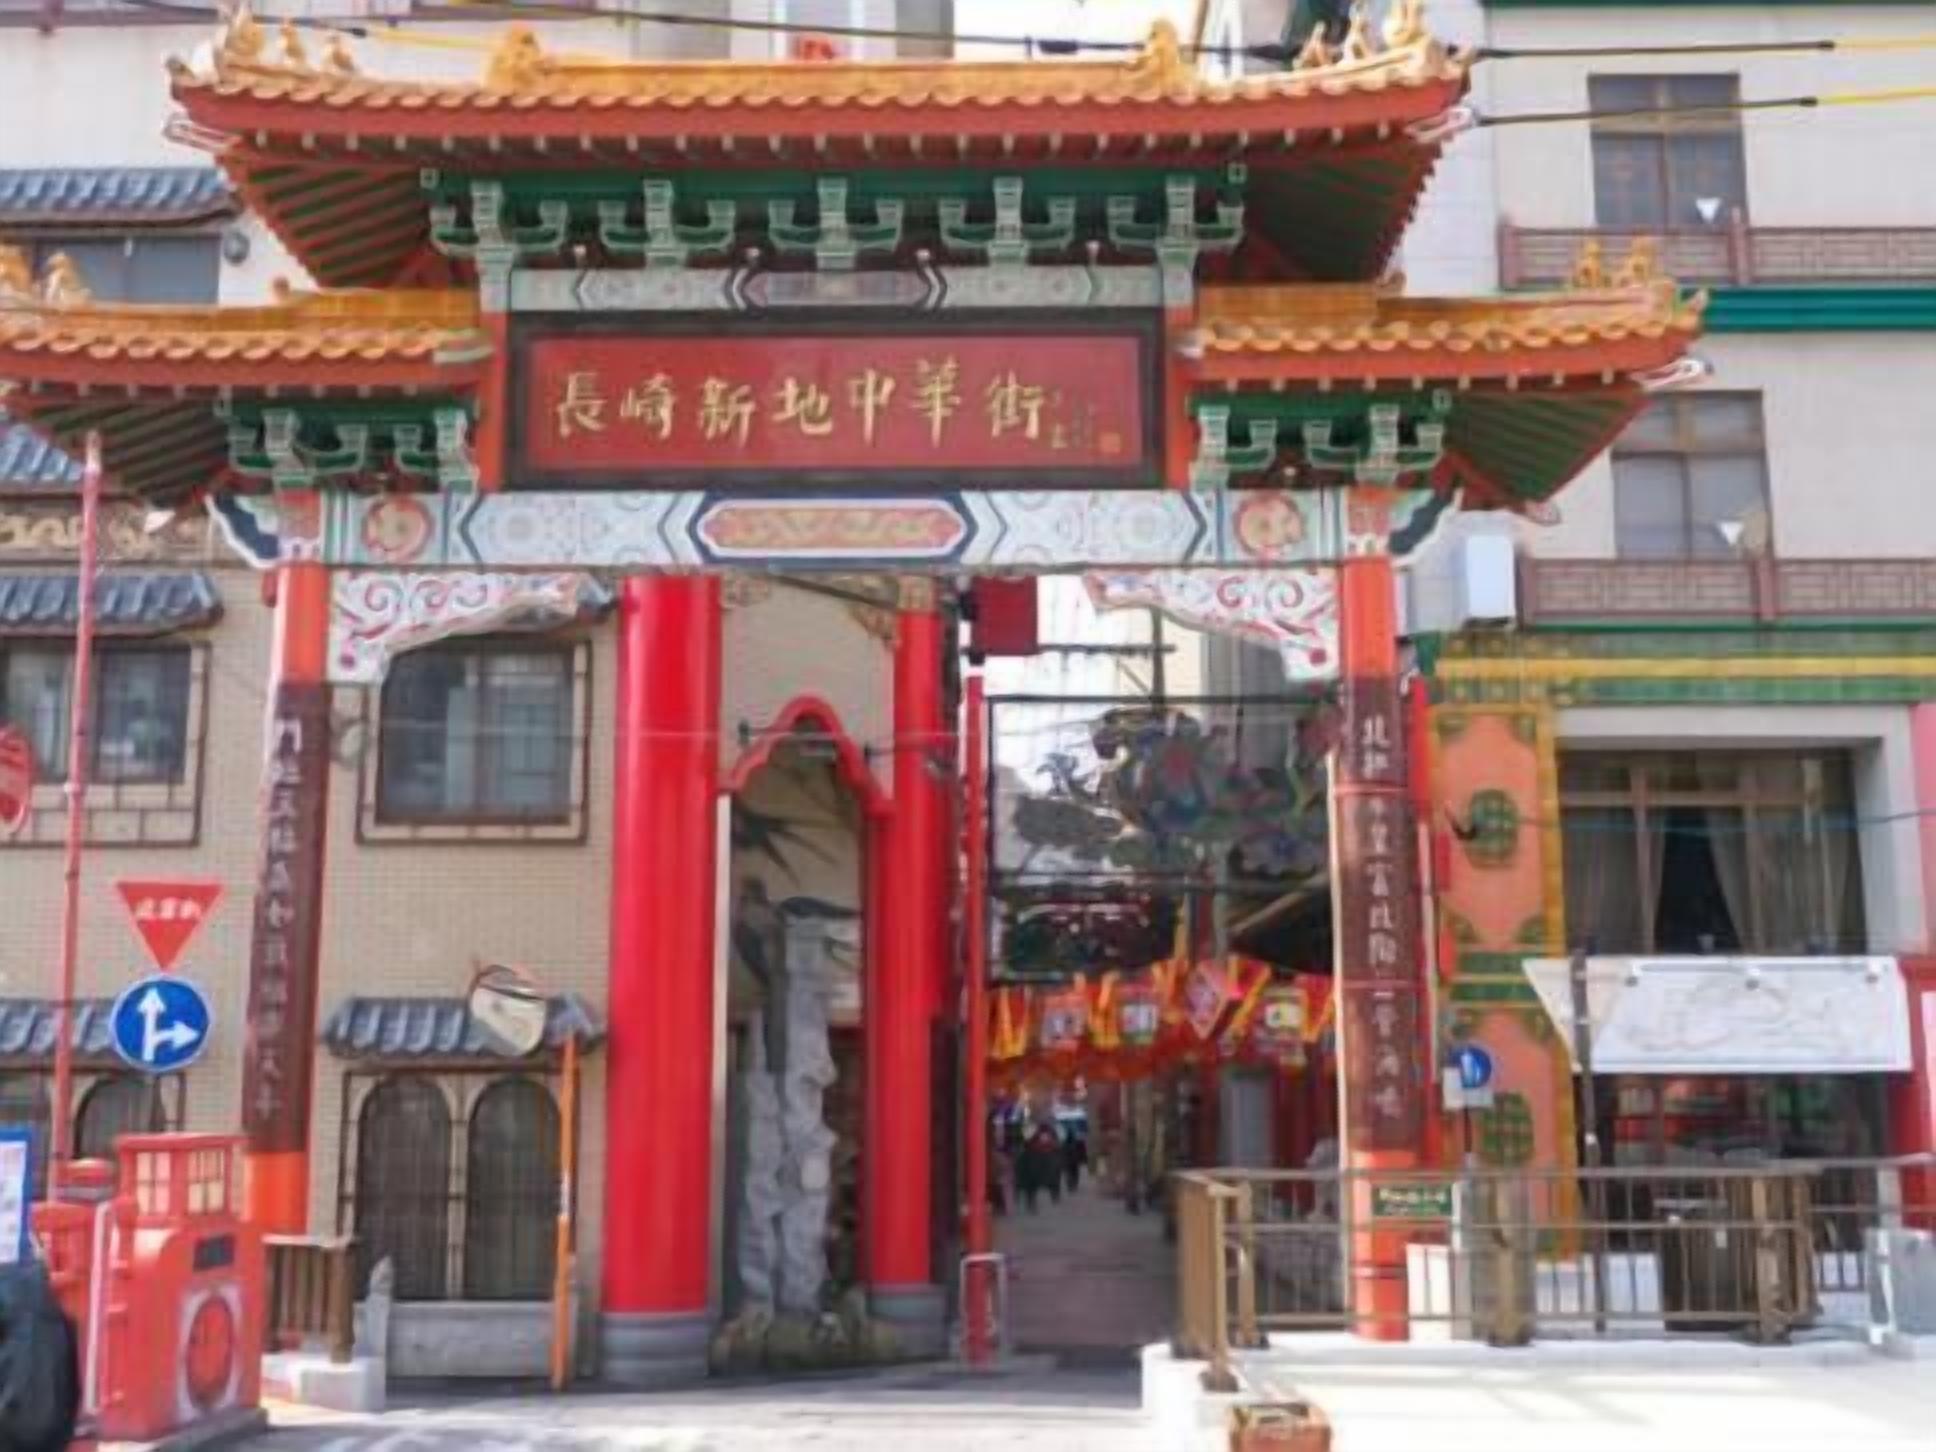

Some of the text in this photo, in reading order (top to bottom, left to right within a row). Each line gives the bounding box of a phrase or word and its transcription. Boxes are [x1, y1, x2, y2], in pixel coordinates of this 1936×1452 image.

[556, 356, 1044, 449] 長崎新地中華街
